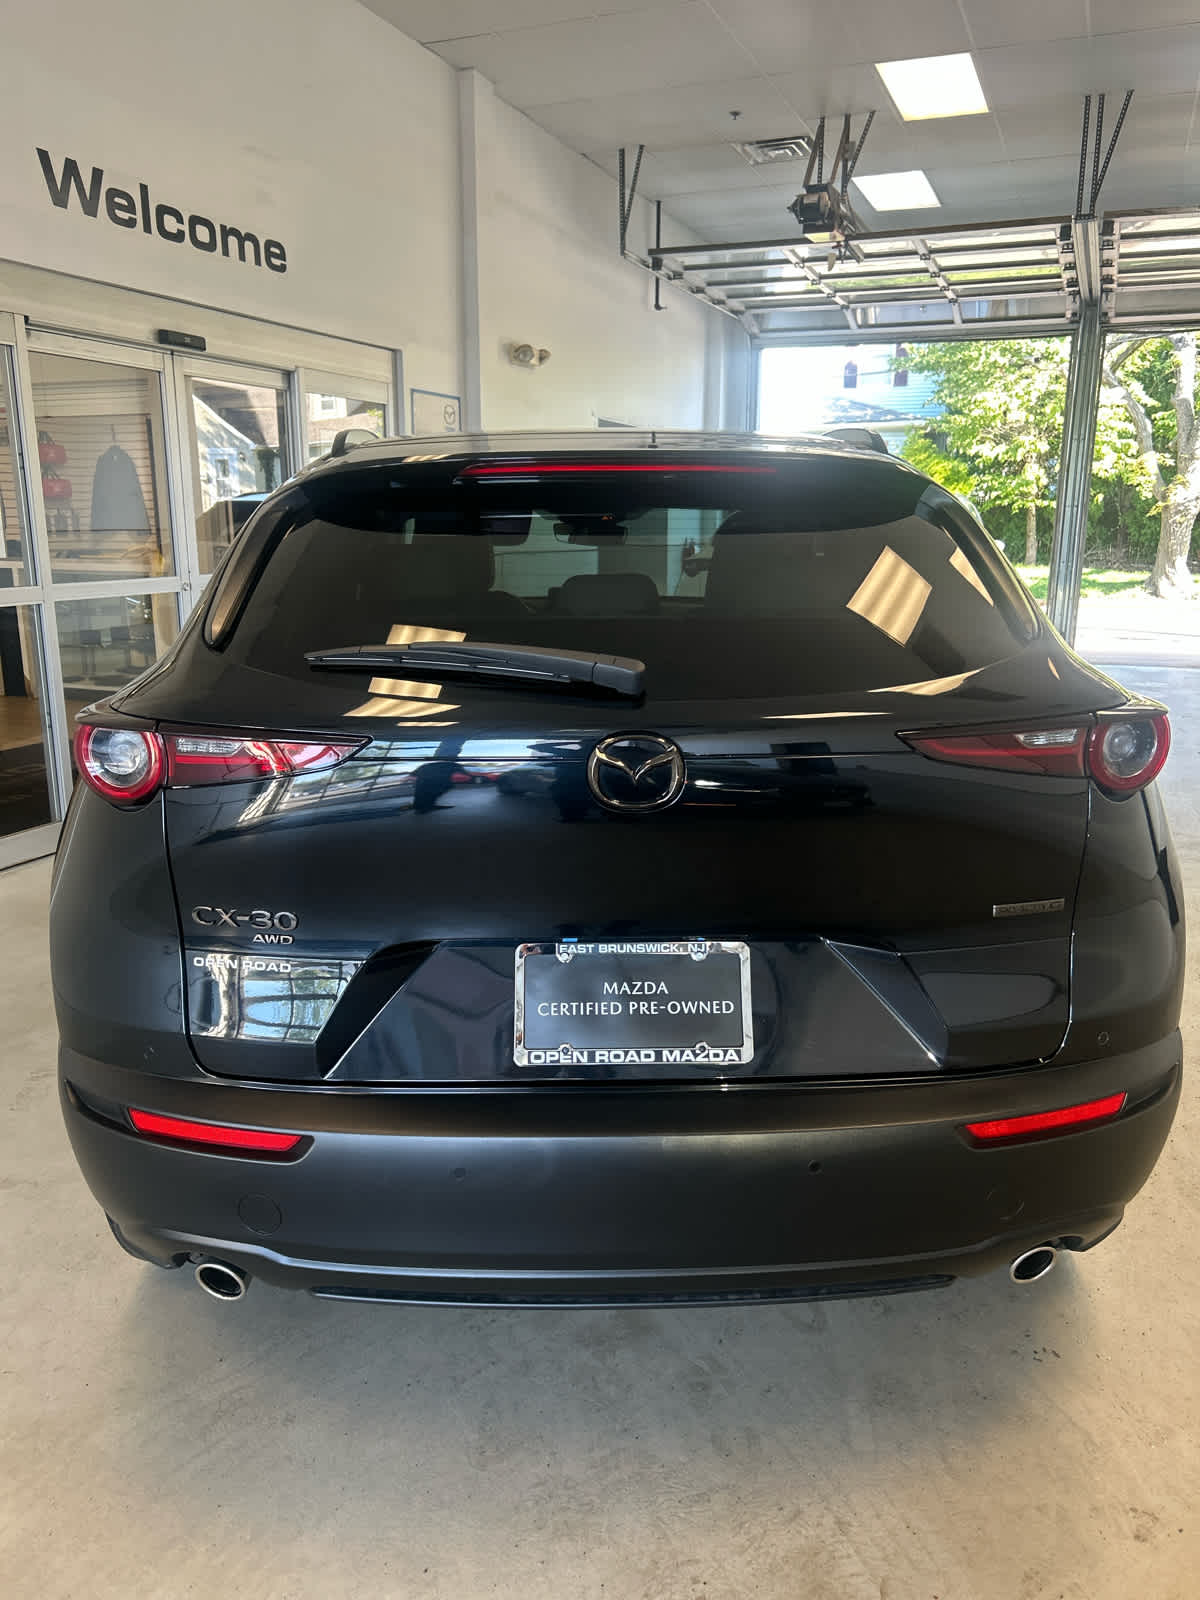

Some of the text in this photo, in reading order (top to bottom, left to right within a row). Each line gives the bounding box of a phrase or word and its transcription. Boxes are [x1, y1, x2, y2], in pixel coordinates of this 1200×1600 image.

[36, 147, 287, 273] Welcome
[192, 906, 298, 931] CX-30
[253, 934, 293, 945] AWD
[560, 944, 594, 954] EAST
[688, 943, 706, 953] NJ
[193, 956, 292, 973] OPEN ROAD
[603, 981, 669, 995] MAZDA
[537, 1000, 735, 1016] CERTIFIED PRE-OWNED
[530, 1051, 588, 1063] OPEN
[595, 1050, 656, 1063] ROAD
